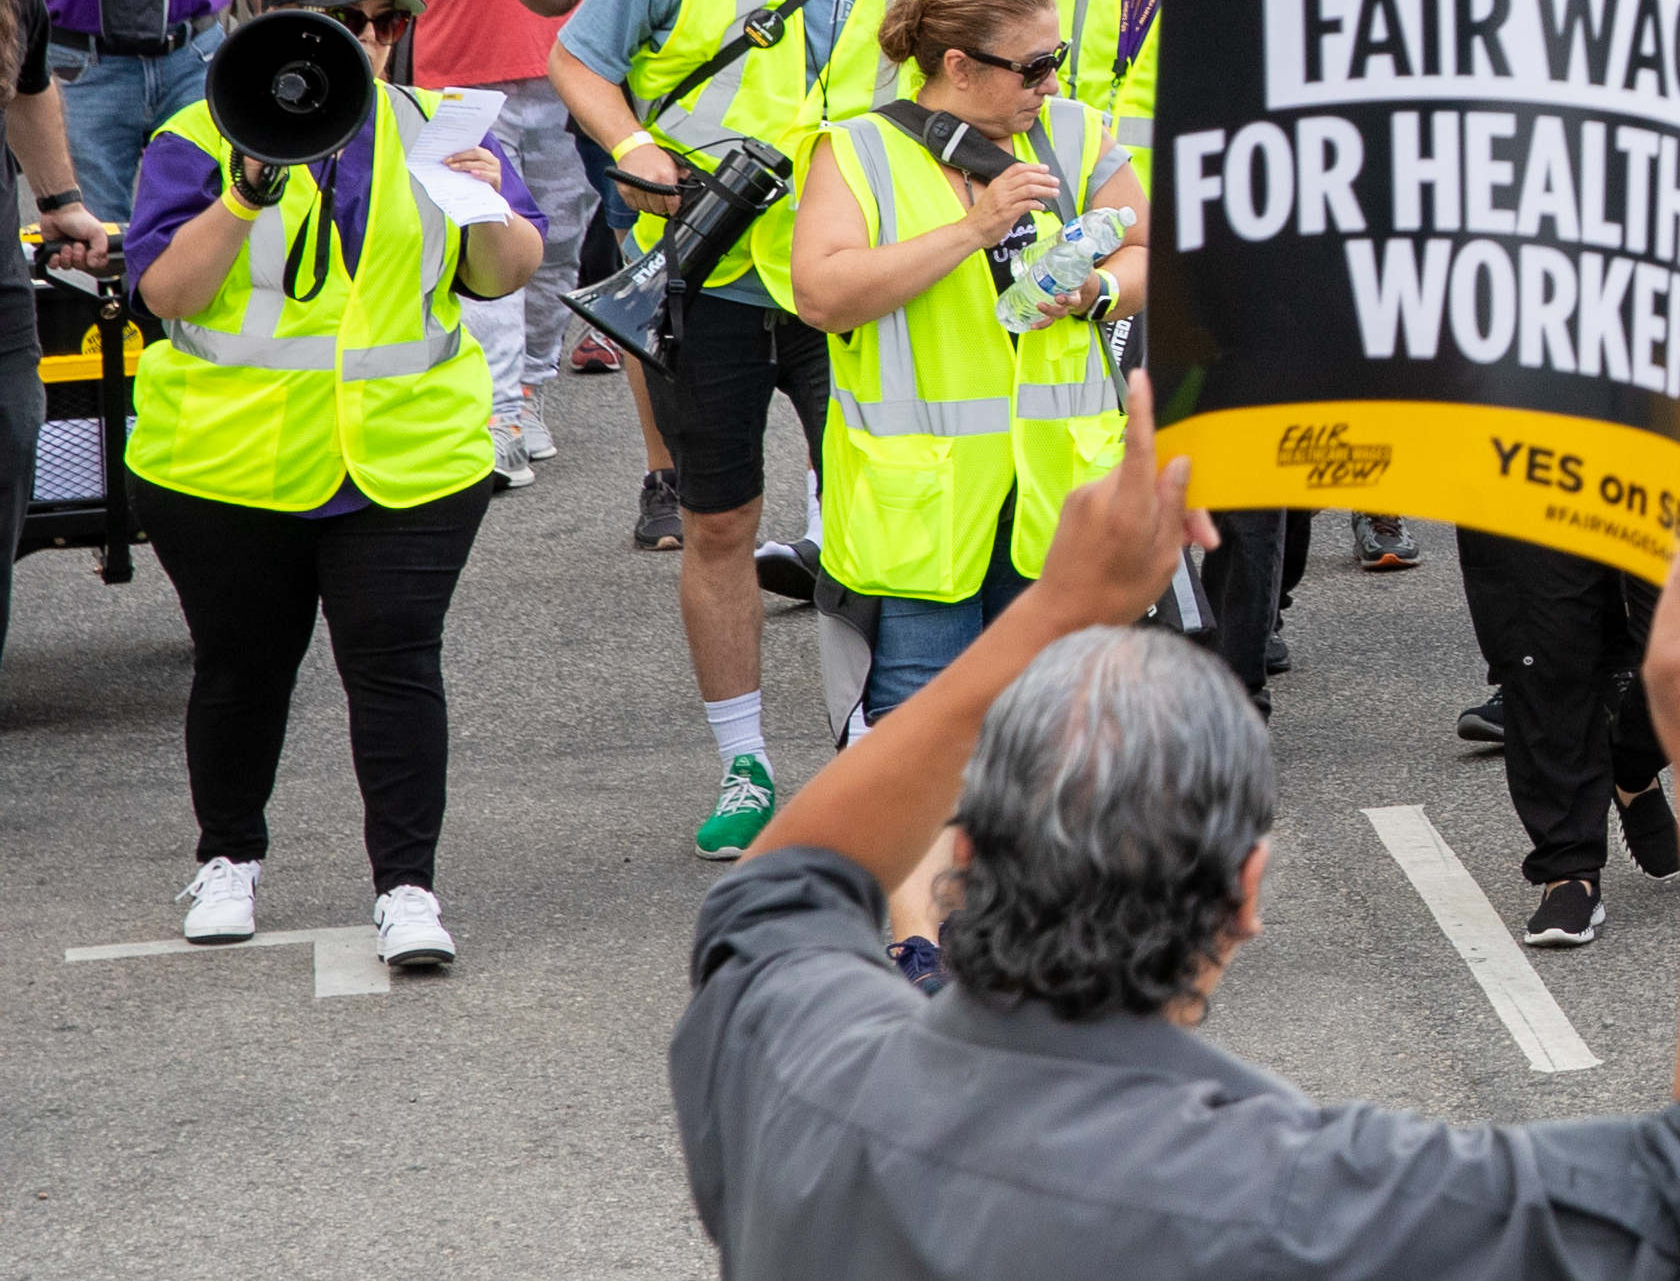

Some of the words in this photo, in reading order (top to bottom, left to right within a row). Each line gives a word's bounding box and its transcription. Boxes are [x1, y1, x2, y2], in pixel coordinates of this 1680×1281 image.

[1175, 116, 1366, 252] FOR
[1279, 423, 1349, 447] FAIR
[1490, 436, 1584, 494] YES
[1599, 473, 1647, 515] on
